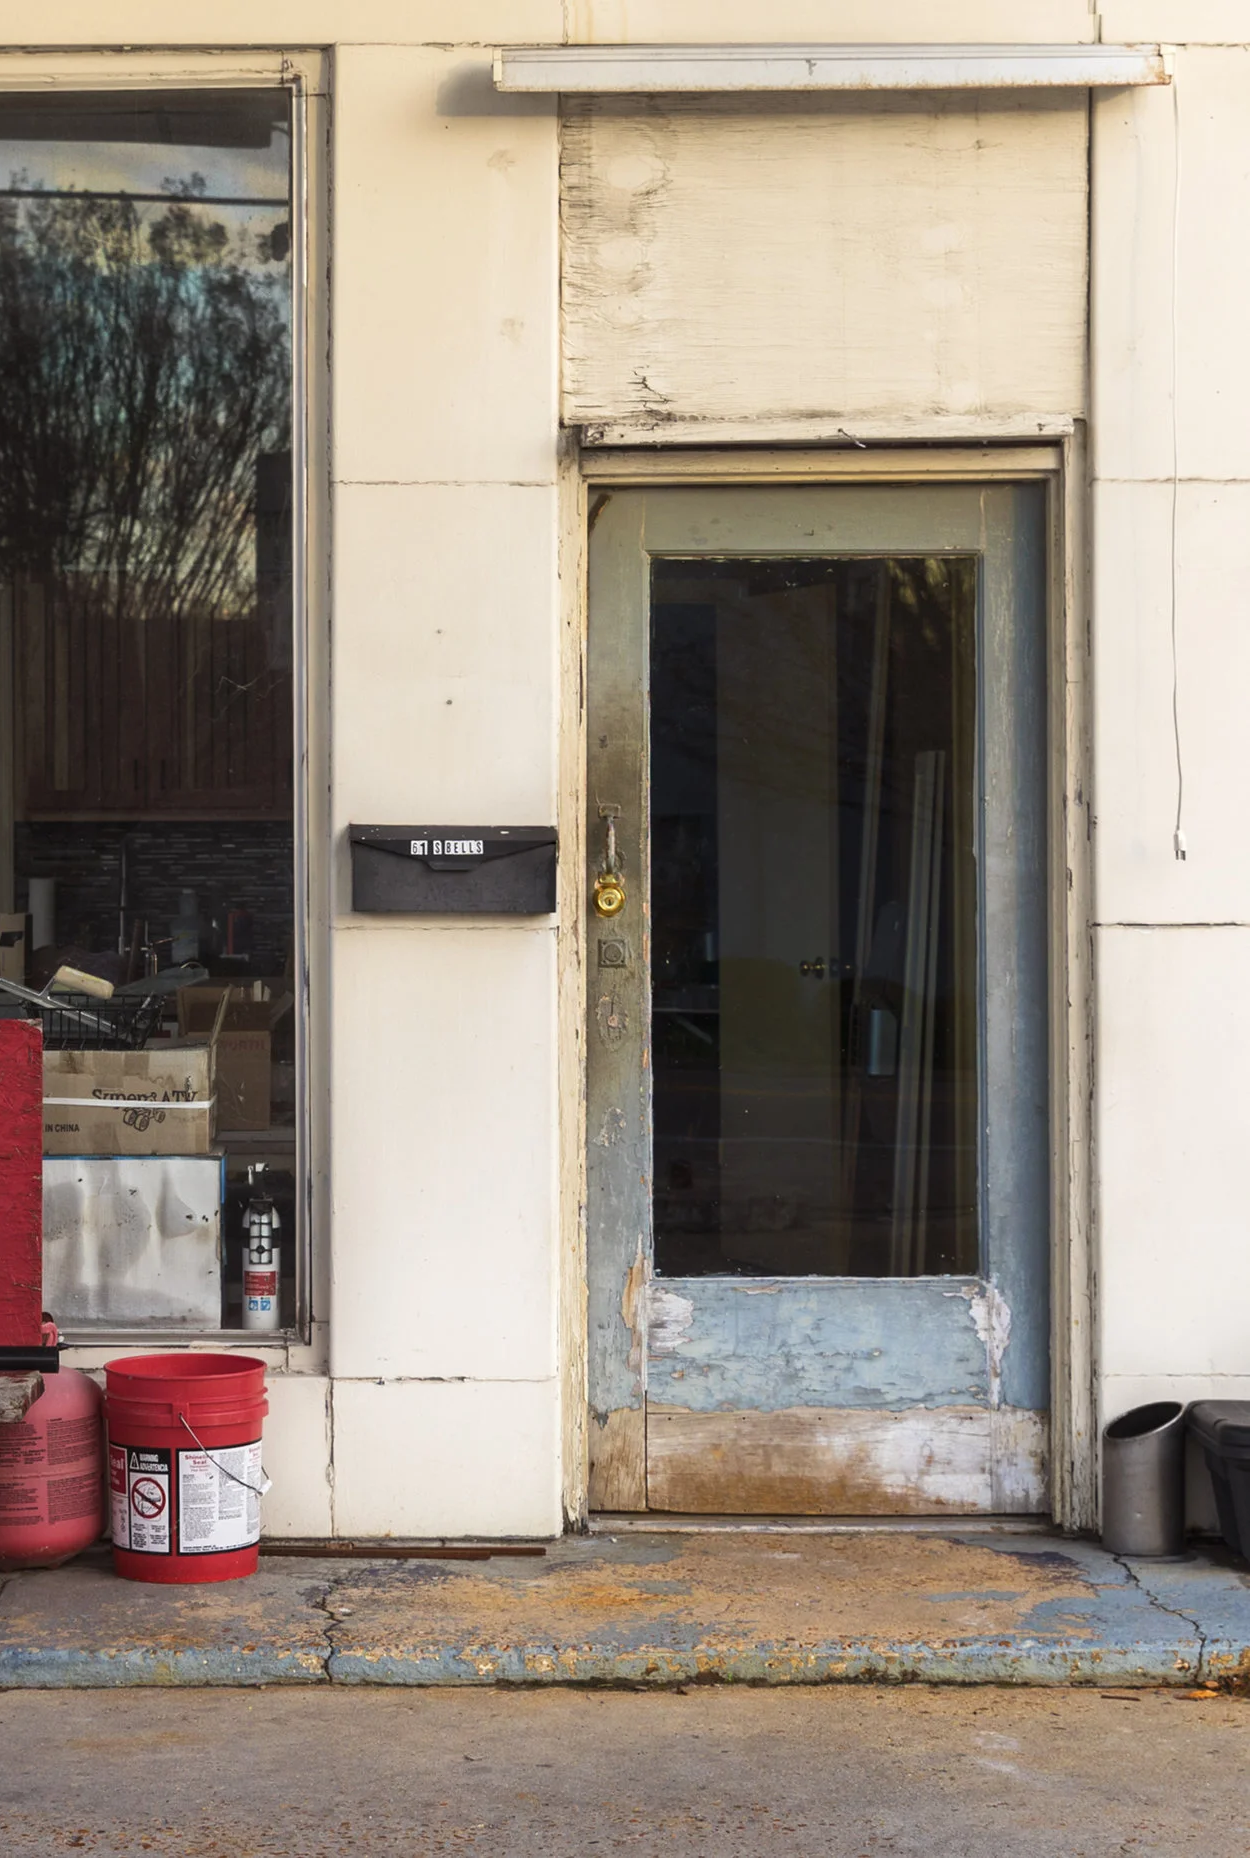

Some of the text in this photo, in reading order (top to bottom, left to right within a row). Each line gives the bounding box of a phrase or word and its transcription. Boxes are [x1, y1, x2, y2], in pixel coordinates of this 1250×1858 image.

[411, 841, 483, 854] 61 S BELLS
[45, 1123, 80, 1133] IN CHINA
